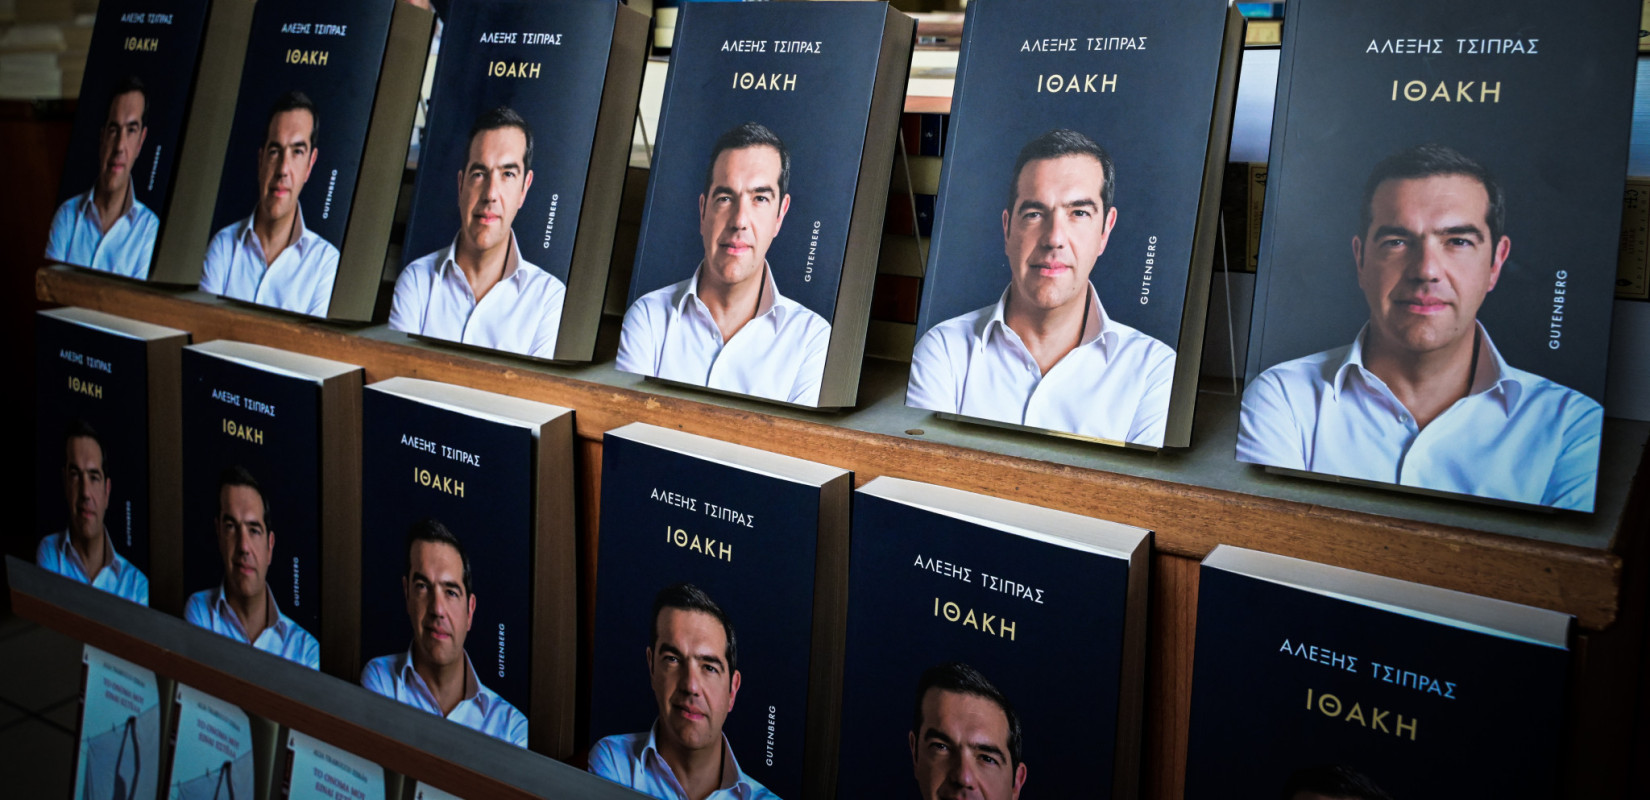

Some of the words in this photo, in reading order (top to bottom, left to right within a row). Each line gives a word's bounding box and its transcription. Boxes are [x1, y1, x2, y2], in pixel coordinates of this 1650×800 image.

[281, 22, 312, 35] ΑΛΕΞΗΣ
[314, 23, 348, 37] ΤΣΙΠΡΑΣ
[479, 32, 518, 44] ΑΛΕΞΗΣ
[522, 32, 563, 46] ΤΣΙΠΡΑΣ
[1020, 38, 1078, 52] ΑΛΕΞΗΣ
[1086, 36, 1148, 51] ΤΣΙΠΡΑΣ
[285, 48, 329, 66] ΙΘΑΚΗ
[720, 40, 768, 53] ΑΛΕΞΗΣ
[774, 40, 823, 54] ΤΣΙΠΡΑΣ
[1365, 38, 1444, 54] ΑΛΕΞΗΣ
[1456, 38, 1539, 54] ΤΣΙΠΡΑΣ
[487, 60, 542, 79] ΙΘΑΚΗ
[732, 71, 797, 92] ΙΘΑΚΗ
[1037, 73, 1118, 93] ΙΘΑΚΗ
[1391, 79, 1501, 104] ΙΘΑΚΗ
[543, 193, 559, 249] GUTENBERG
[804, 220, 821, 283] GUTENBERG
[1140, 235, 1158, 305] GUTENBERG
[1548, 269, 1568, 350] GUTENBERG
[211, 388, 241, 407] ΑΛΕΞΗΣ
[243, 397, 276, 417] ΤΣΙΠΡΑΣ
[222, 418, 264, 445] ΙΘΑΚΗ
[400, 433, 437, 455] ΑΛΕΞΗΣ
[441, 445, 481, 468] ΤΣΙΠΡΑΣ
[414, 466, 466, 498] ΙΘΑΚΗ
[650, 487, 697, 512] ΑΛΕΞΗΣ
[704, 502, 754, 529] ΤΣΙΠΡΑΣ
[666, 525, 733, 563] ΙΘΑΚΗ
[913, 554, 972, 584] ΑΛΕΞΗΣ
[981, 572, 1045, 604] ΤΣΙΠΡΑΣ
[934, 597, 1018, 641] ΙΘΑΚΗ
[1279, 638, 1359, 673] ΑΛΕΞΗΣ
[1371, 662, 1457, 700] ΤΣΙΠΡΑΣ
[1306, 687, 1417, 741] ΙΘΑΚΗ
[765, 705, 776, 767] GUTENBERG
